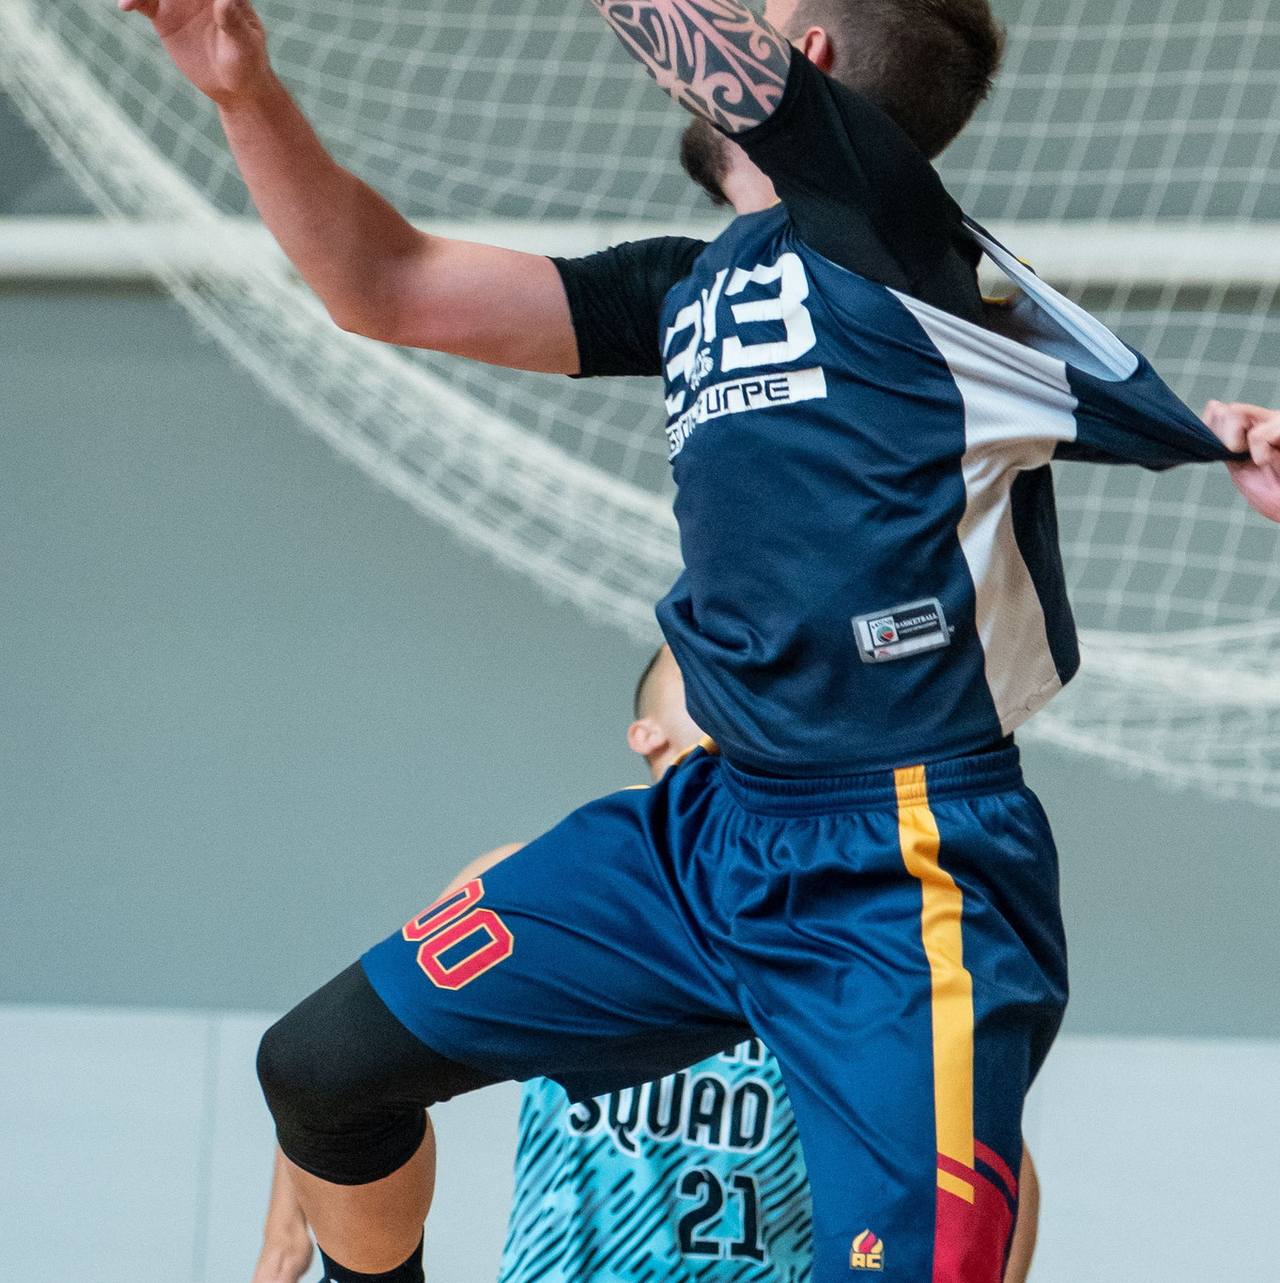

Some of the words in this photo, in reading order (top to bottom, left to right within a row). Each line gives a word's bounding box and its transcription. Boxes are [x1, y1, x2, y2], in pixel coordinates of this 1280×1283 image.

[402, 878, 514, 991] 00
[677, 1166, 768, 1267] 21
[851, 1252, 881, 1269] AC
